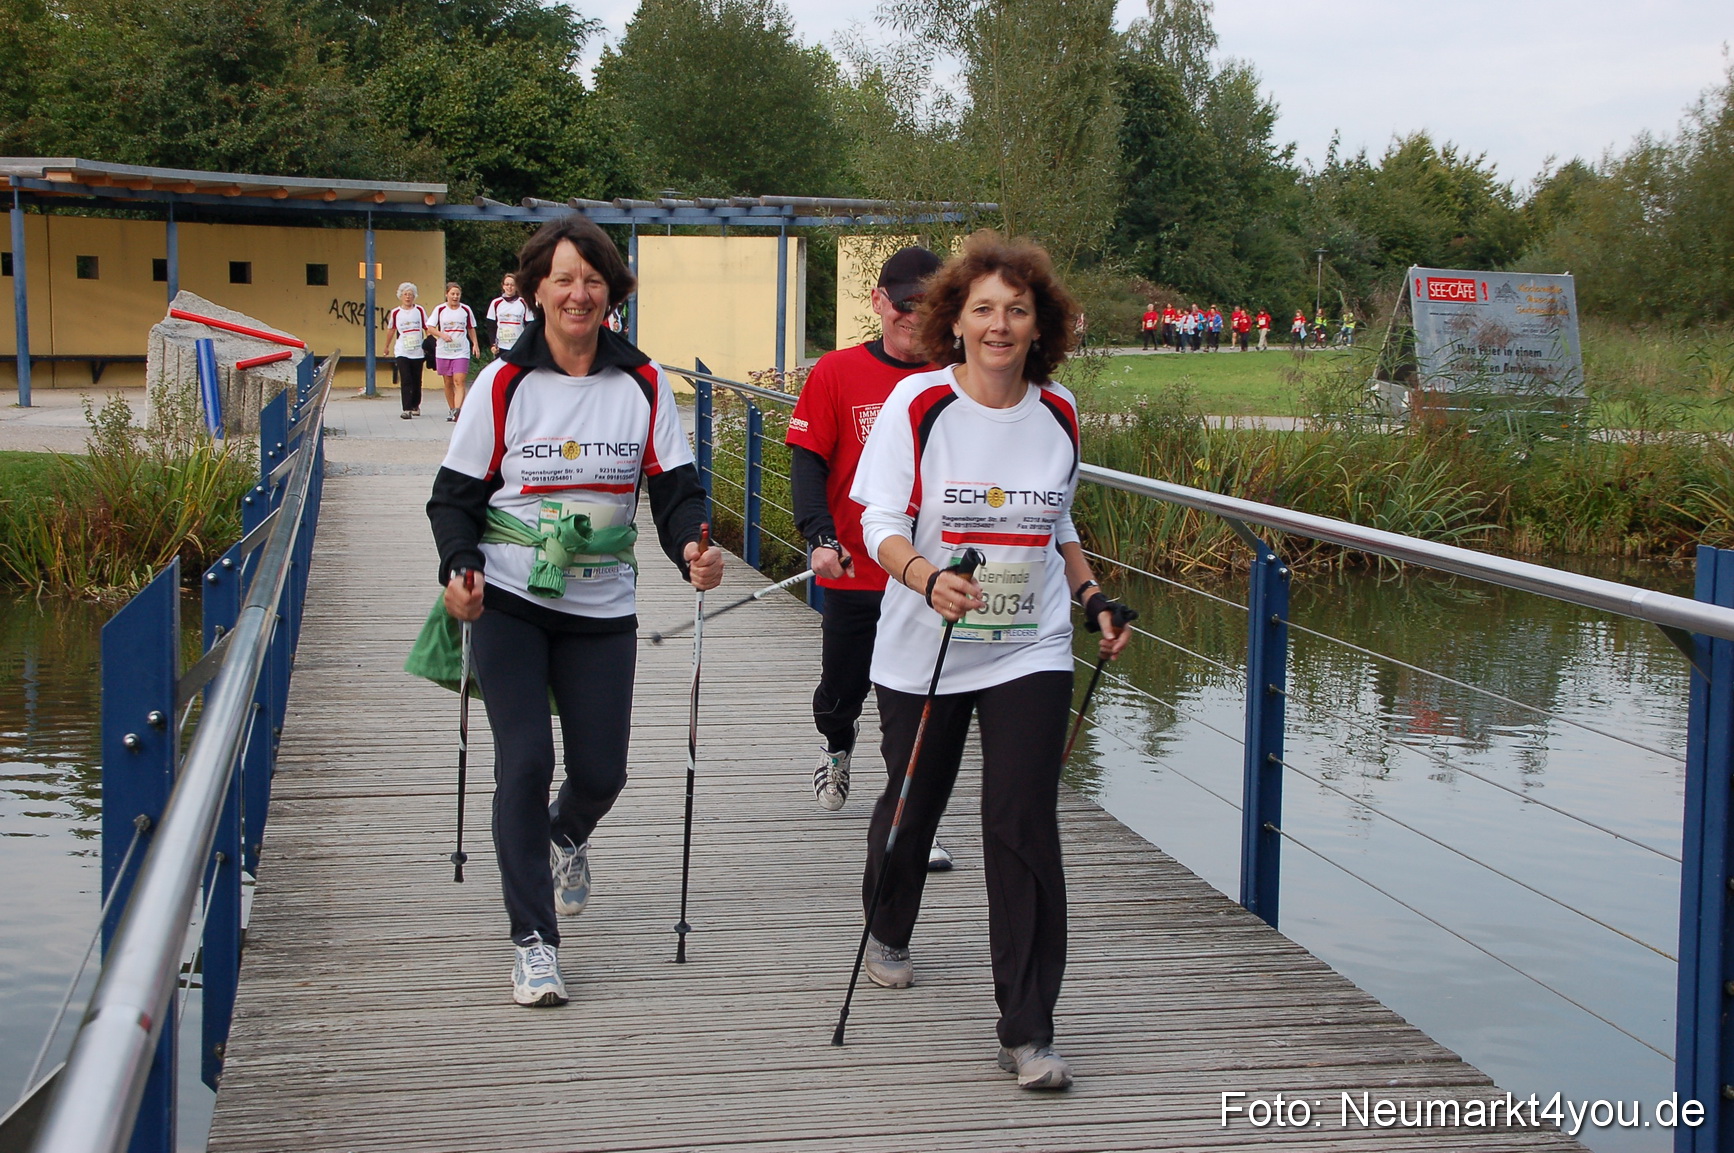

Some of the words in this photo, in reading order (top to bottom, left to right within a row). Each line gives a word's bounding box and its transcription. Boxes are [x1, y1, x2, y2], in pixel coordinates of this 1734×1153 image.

[1457, 344, 1476, 355] Ihre
[1504, 346, 1513, 356] in
[1515, 346, 1542, 357] einem
[978, 566, 1030, 584] Gerlinde
